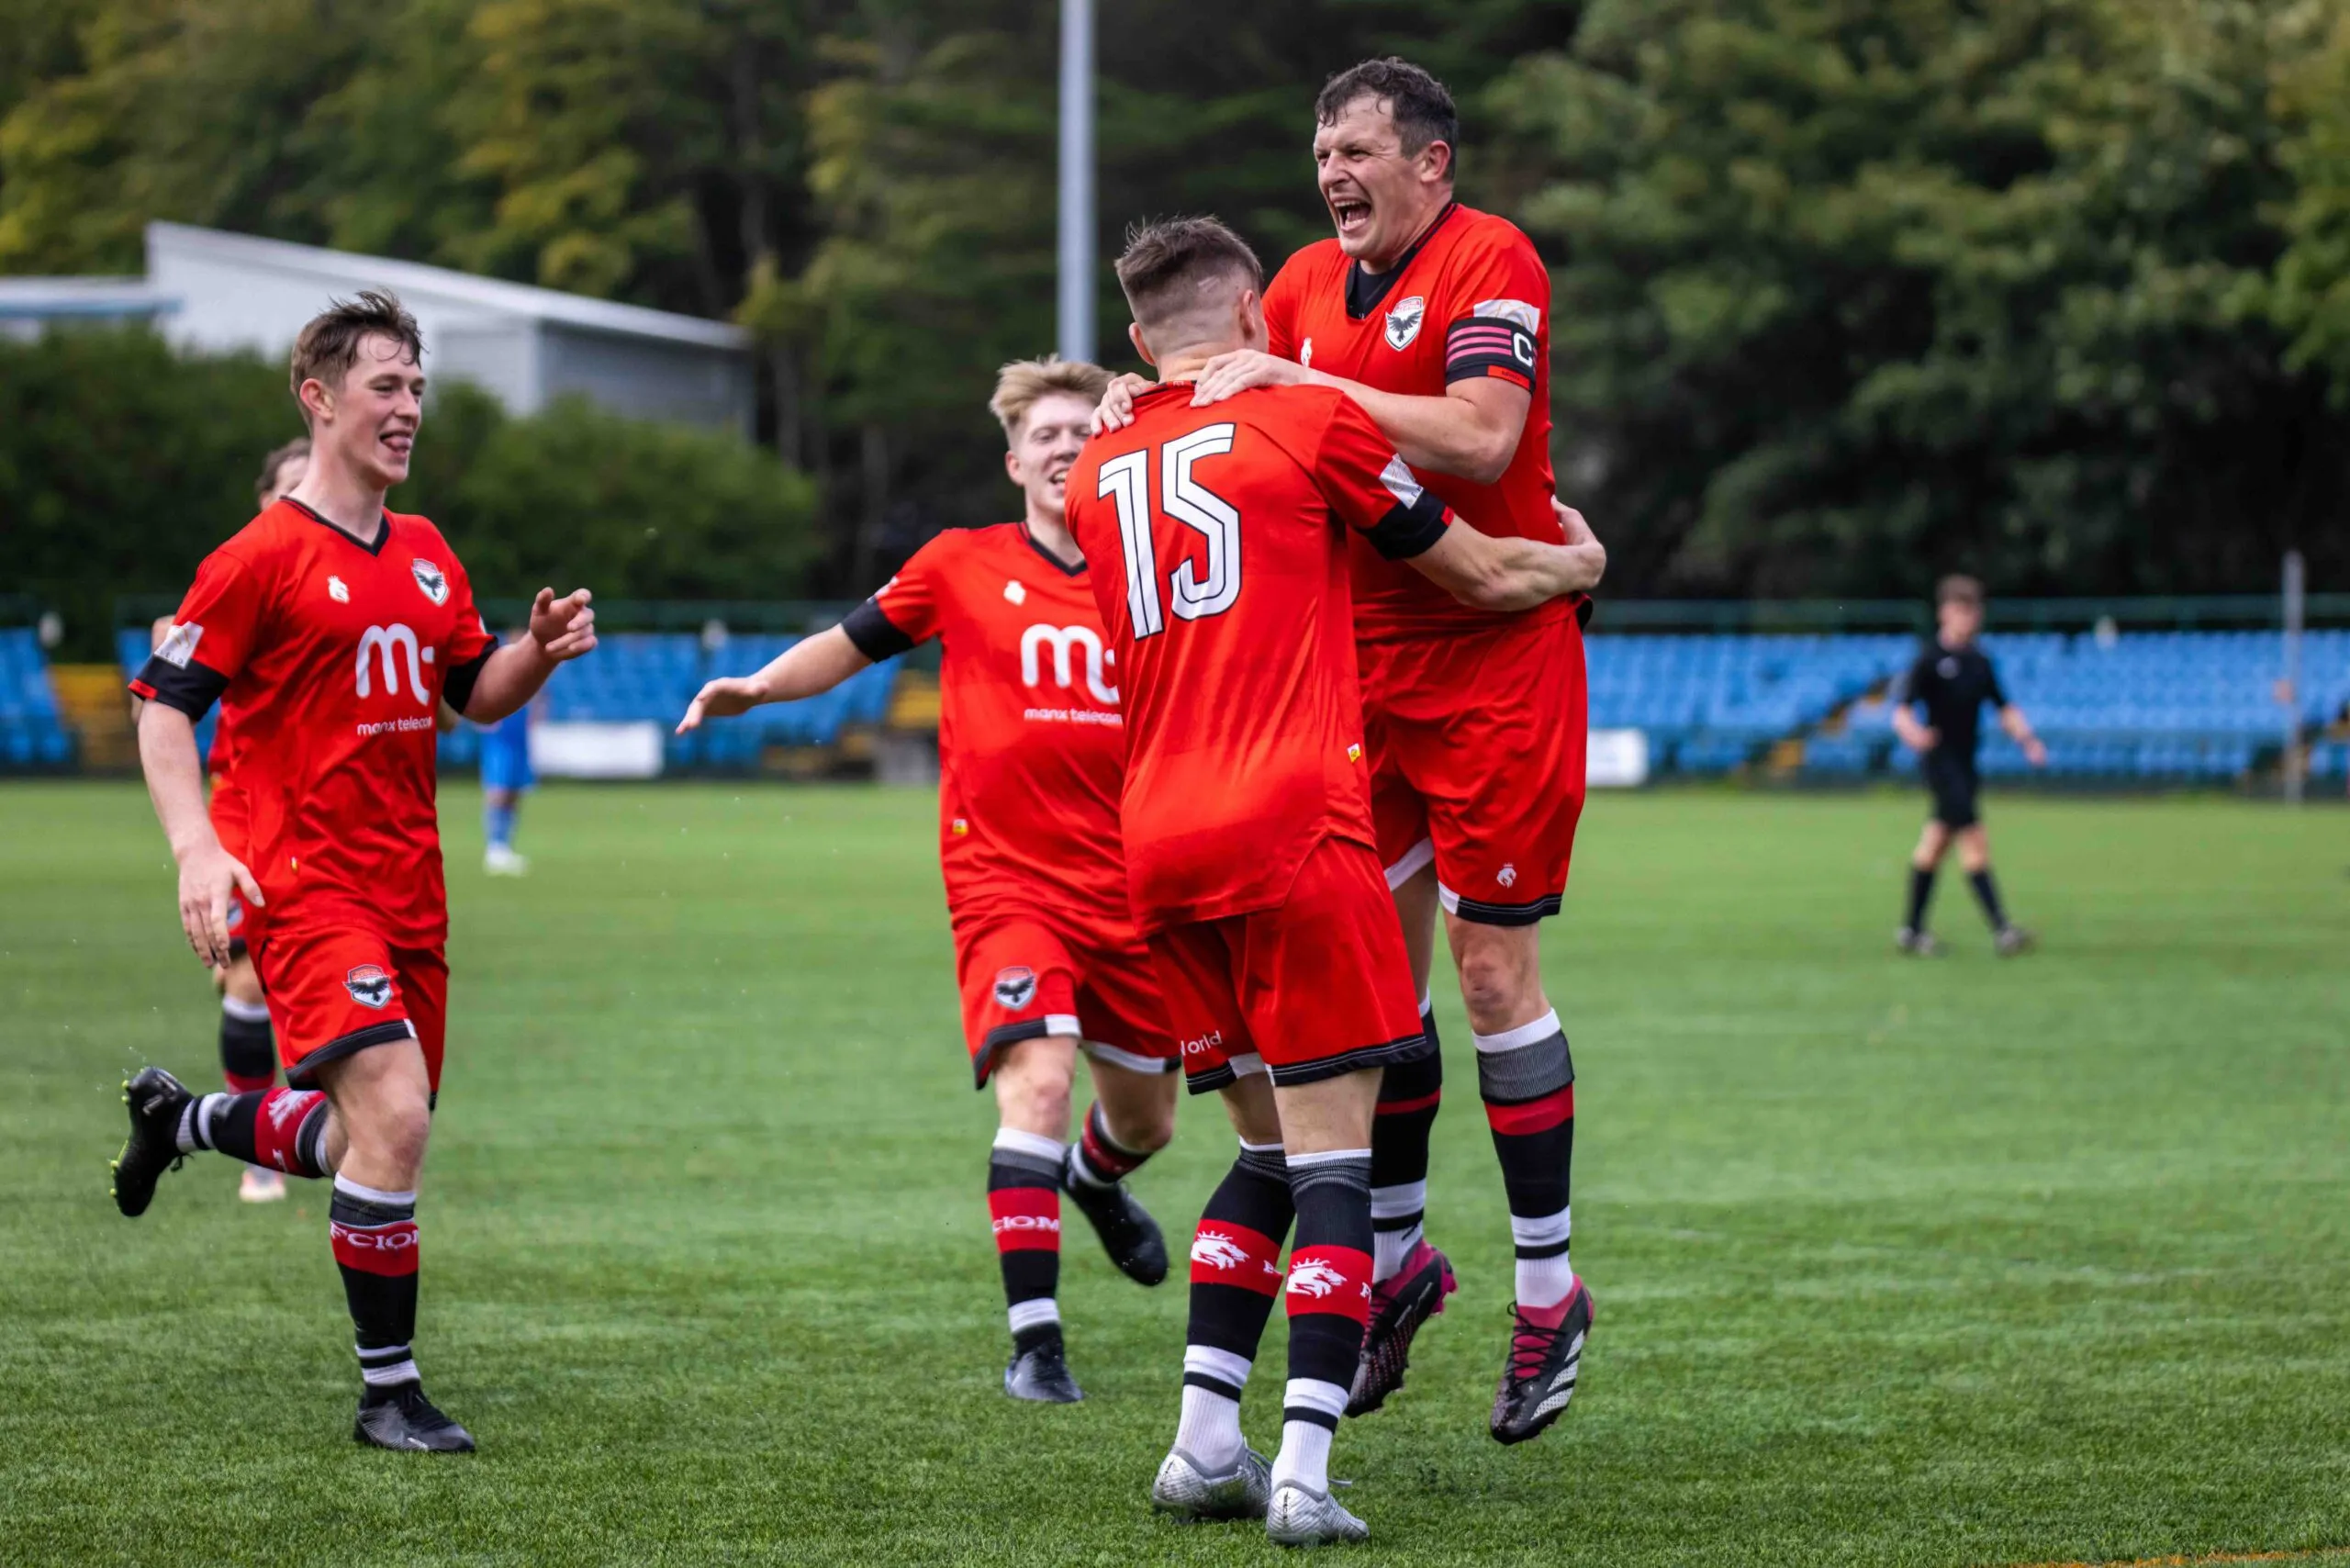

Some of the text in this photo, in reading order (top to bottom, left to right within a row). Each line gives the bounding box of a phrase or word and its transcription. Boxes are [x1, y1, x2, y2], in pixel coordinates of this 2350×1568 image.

[1513, 332, 1533, 367] C
[1097, 421, 1242, 641] 15
[1024, 708, 1069, 722] manx
[357, 721, 396, 736] manx
